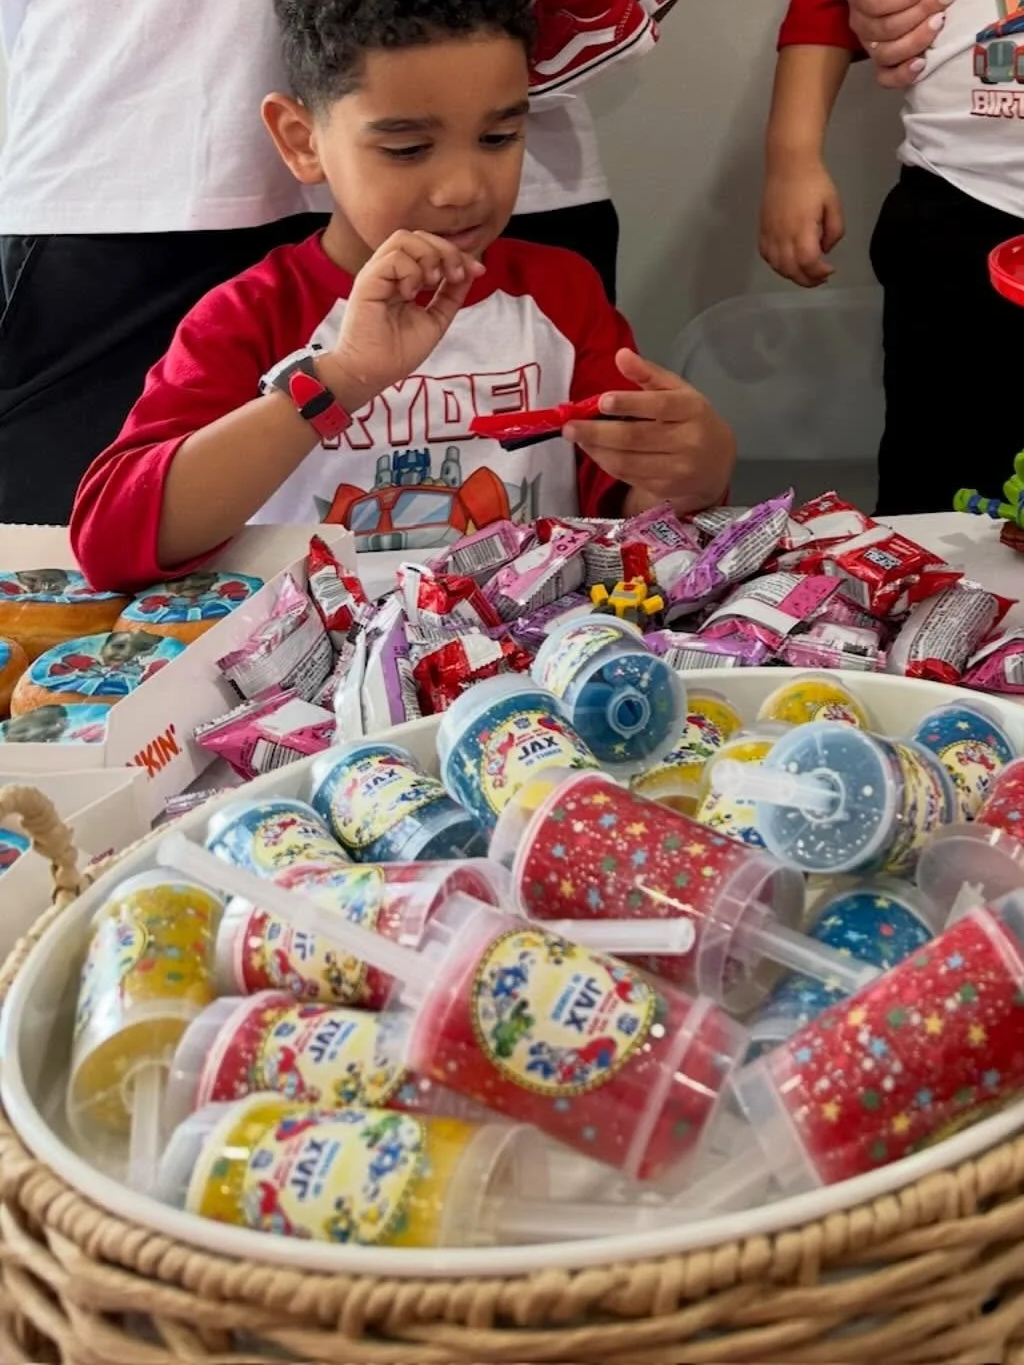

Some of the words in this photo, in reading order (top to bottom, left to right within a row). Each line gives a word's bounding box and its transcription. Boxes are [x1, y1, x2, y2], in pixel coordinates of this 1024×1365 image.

[518, 735, 559, 761] JAX
[564, 977, 603, 1033] JAX
[309, 1018, 342, 1063] JAX
[291, 1138, 326, 1201] JAX
